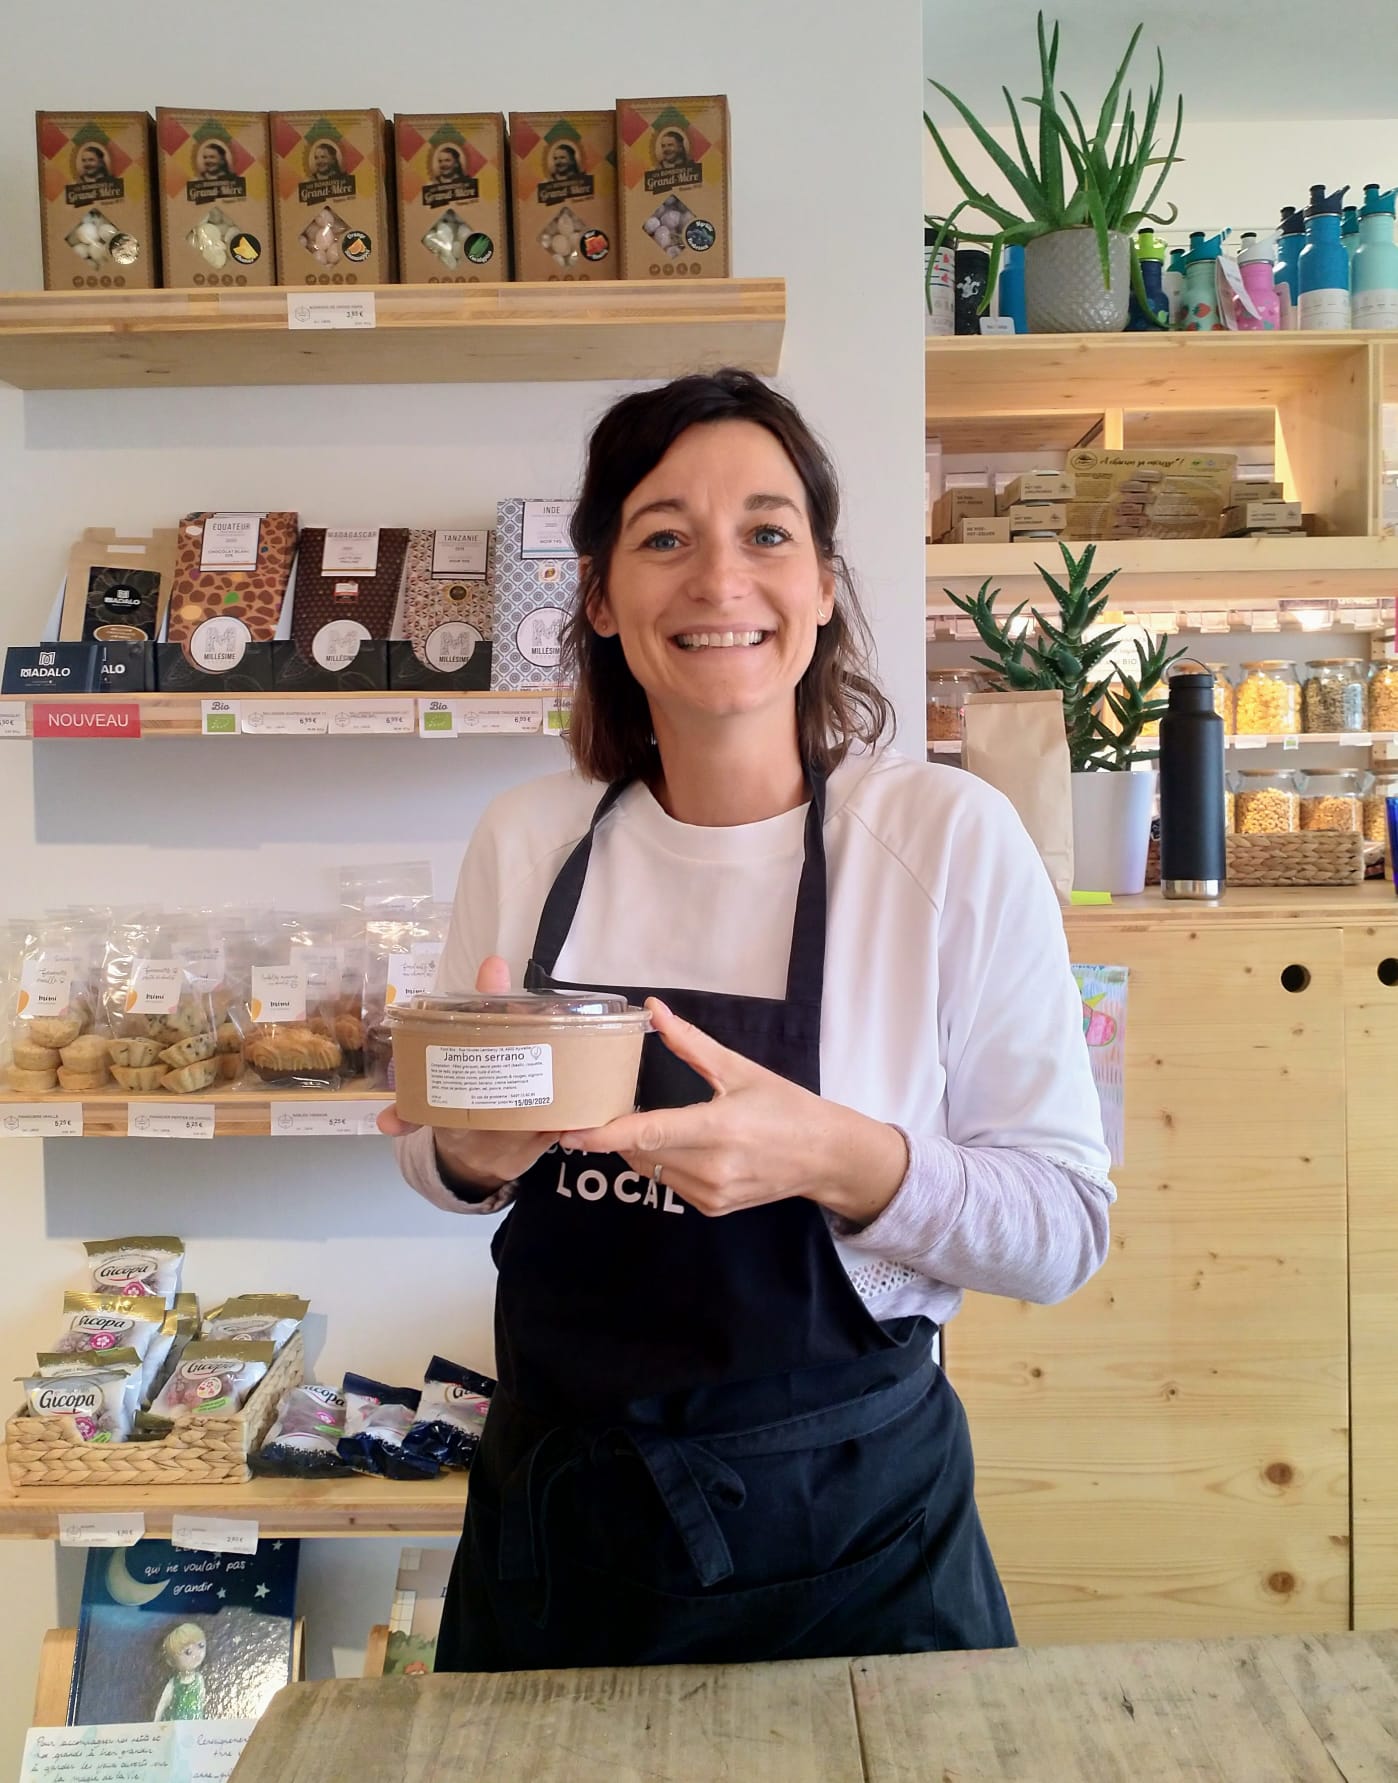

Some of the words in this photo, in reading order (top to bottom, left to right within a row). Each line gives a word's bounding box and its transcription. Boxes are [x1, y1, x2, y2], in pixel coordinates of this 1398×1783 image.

[443, 534, 479, 542] TANZANIE
[211, 701, 230, 712] Bio
[429, 701, 448, 711] Bio
[48, 713, 129, 727] NOUVEAU
[444, 1052, 482, 1062] Jambon
[484, 1053, 525, 1062] serrano
[514, 1097, 550, 1107] 15/09/2022
[556, 1161, 685, 1215] LOCAL
[100, 1264, 149, 1280] Gicopa
[39, 1390, 96, 1415] Gicopa
[145, 1565, 161, 1578] qui
[184, 1559, 221, 1573] voulait
[226, 1560, 246, 1573] pas
[173, 1581, 213, 1596] grandir
